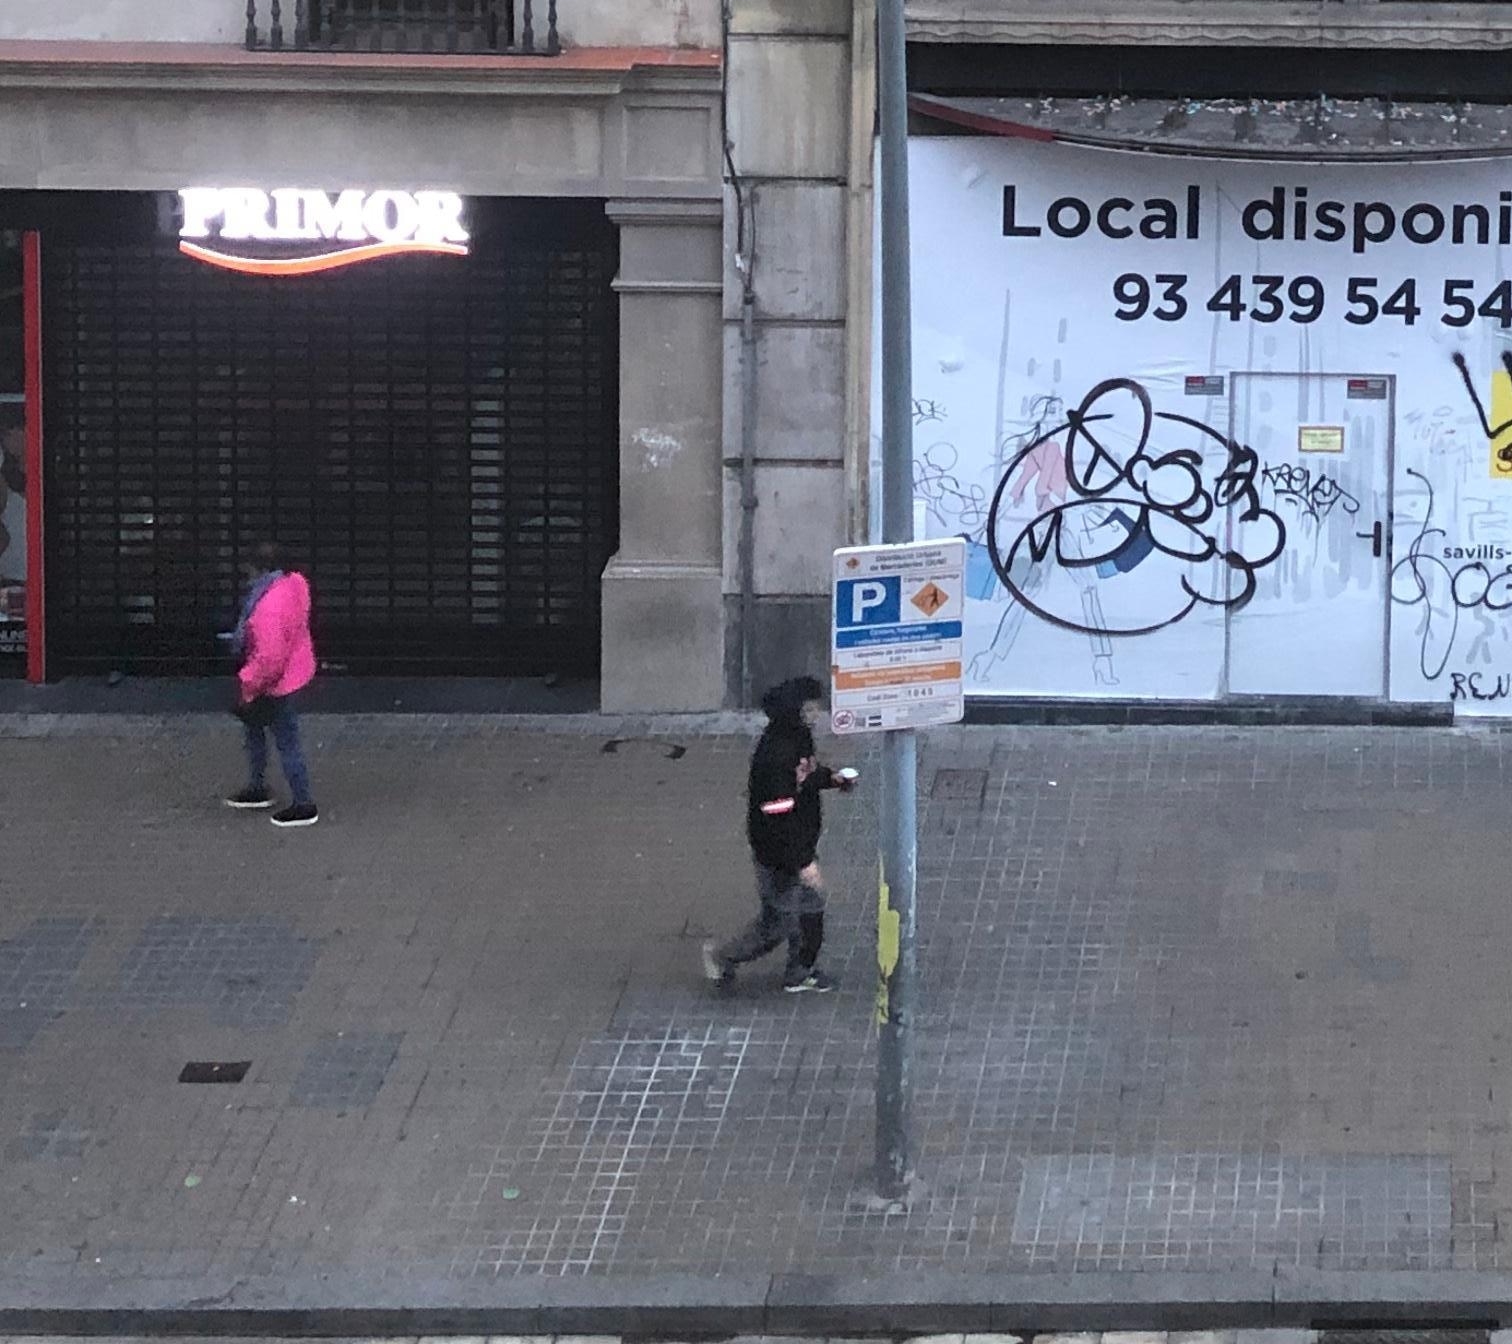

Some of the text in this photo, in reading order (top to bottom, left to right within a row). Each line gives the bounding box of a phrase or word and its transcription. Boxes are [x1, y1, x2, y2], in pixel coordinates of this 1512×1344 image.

[178, 187, 469, 242] PRIMOR
[1002, 184, 1201, 240] Local
[1112, 273, 1189, 324] 93
[1205, 274, 1326, 326] 439
[1343, 277, 1421, 326] 54
[852, 582, 887, 623] P
